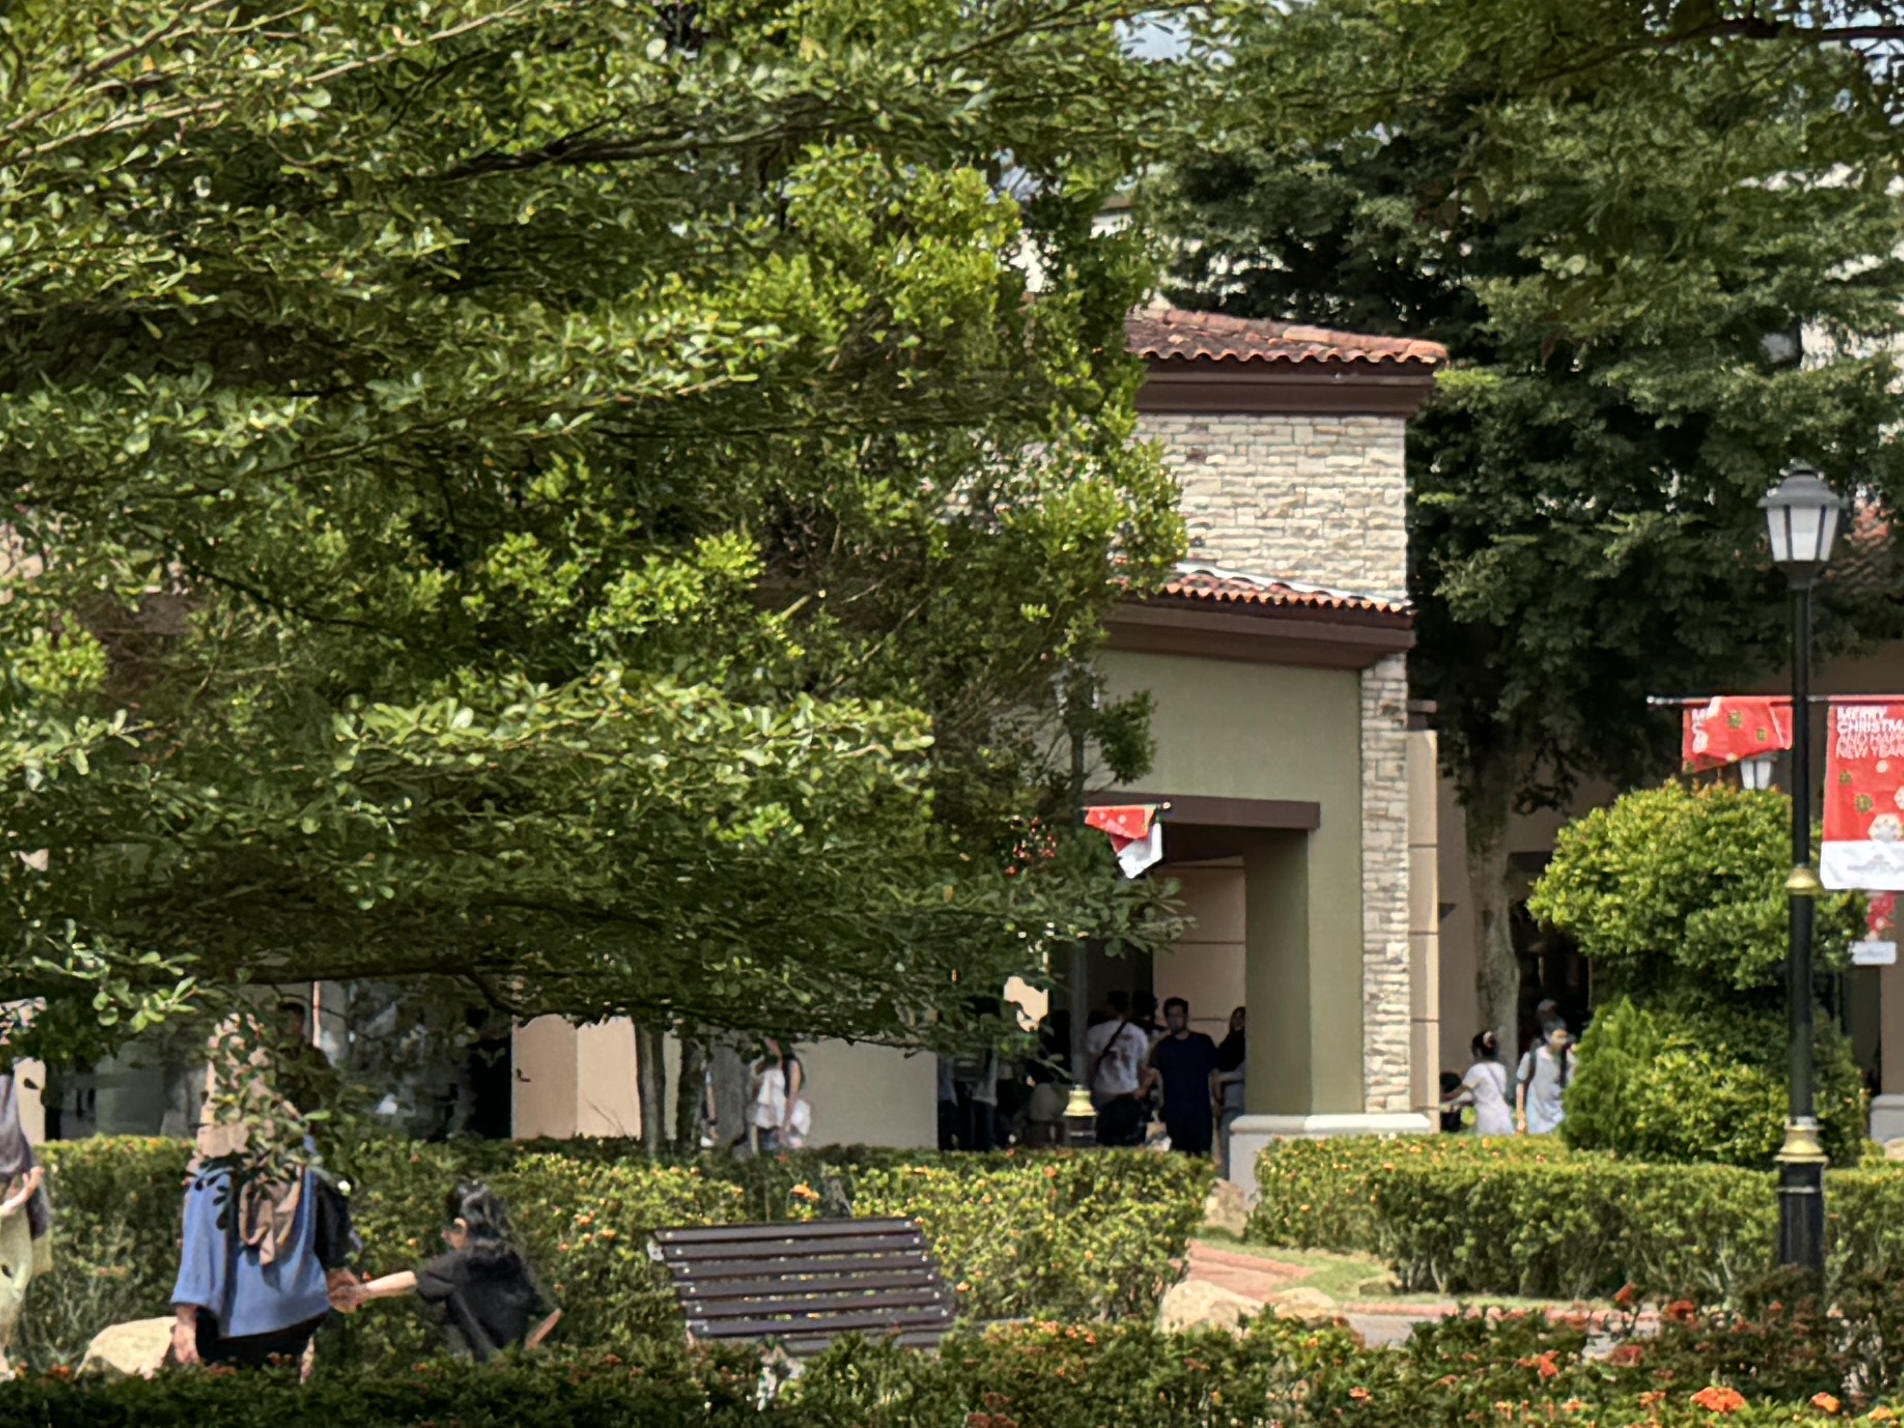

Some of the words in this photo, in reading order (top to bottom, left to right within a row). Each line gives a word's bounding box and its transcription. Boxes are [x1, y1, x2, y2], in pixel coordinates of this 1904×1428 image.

[1837, 705, 1888, 720] MERRY
[1838, 732, 1868, 746] AND
[1836, 744, 1869, 759] NEW
